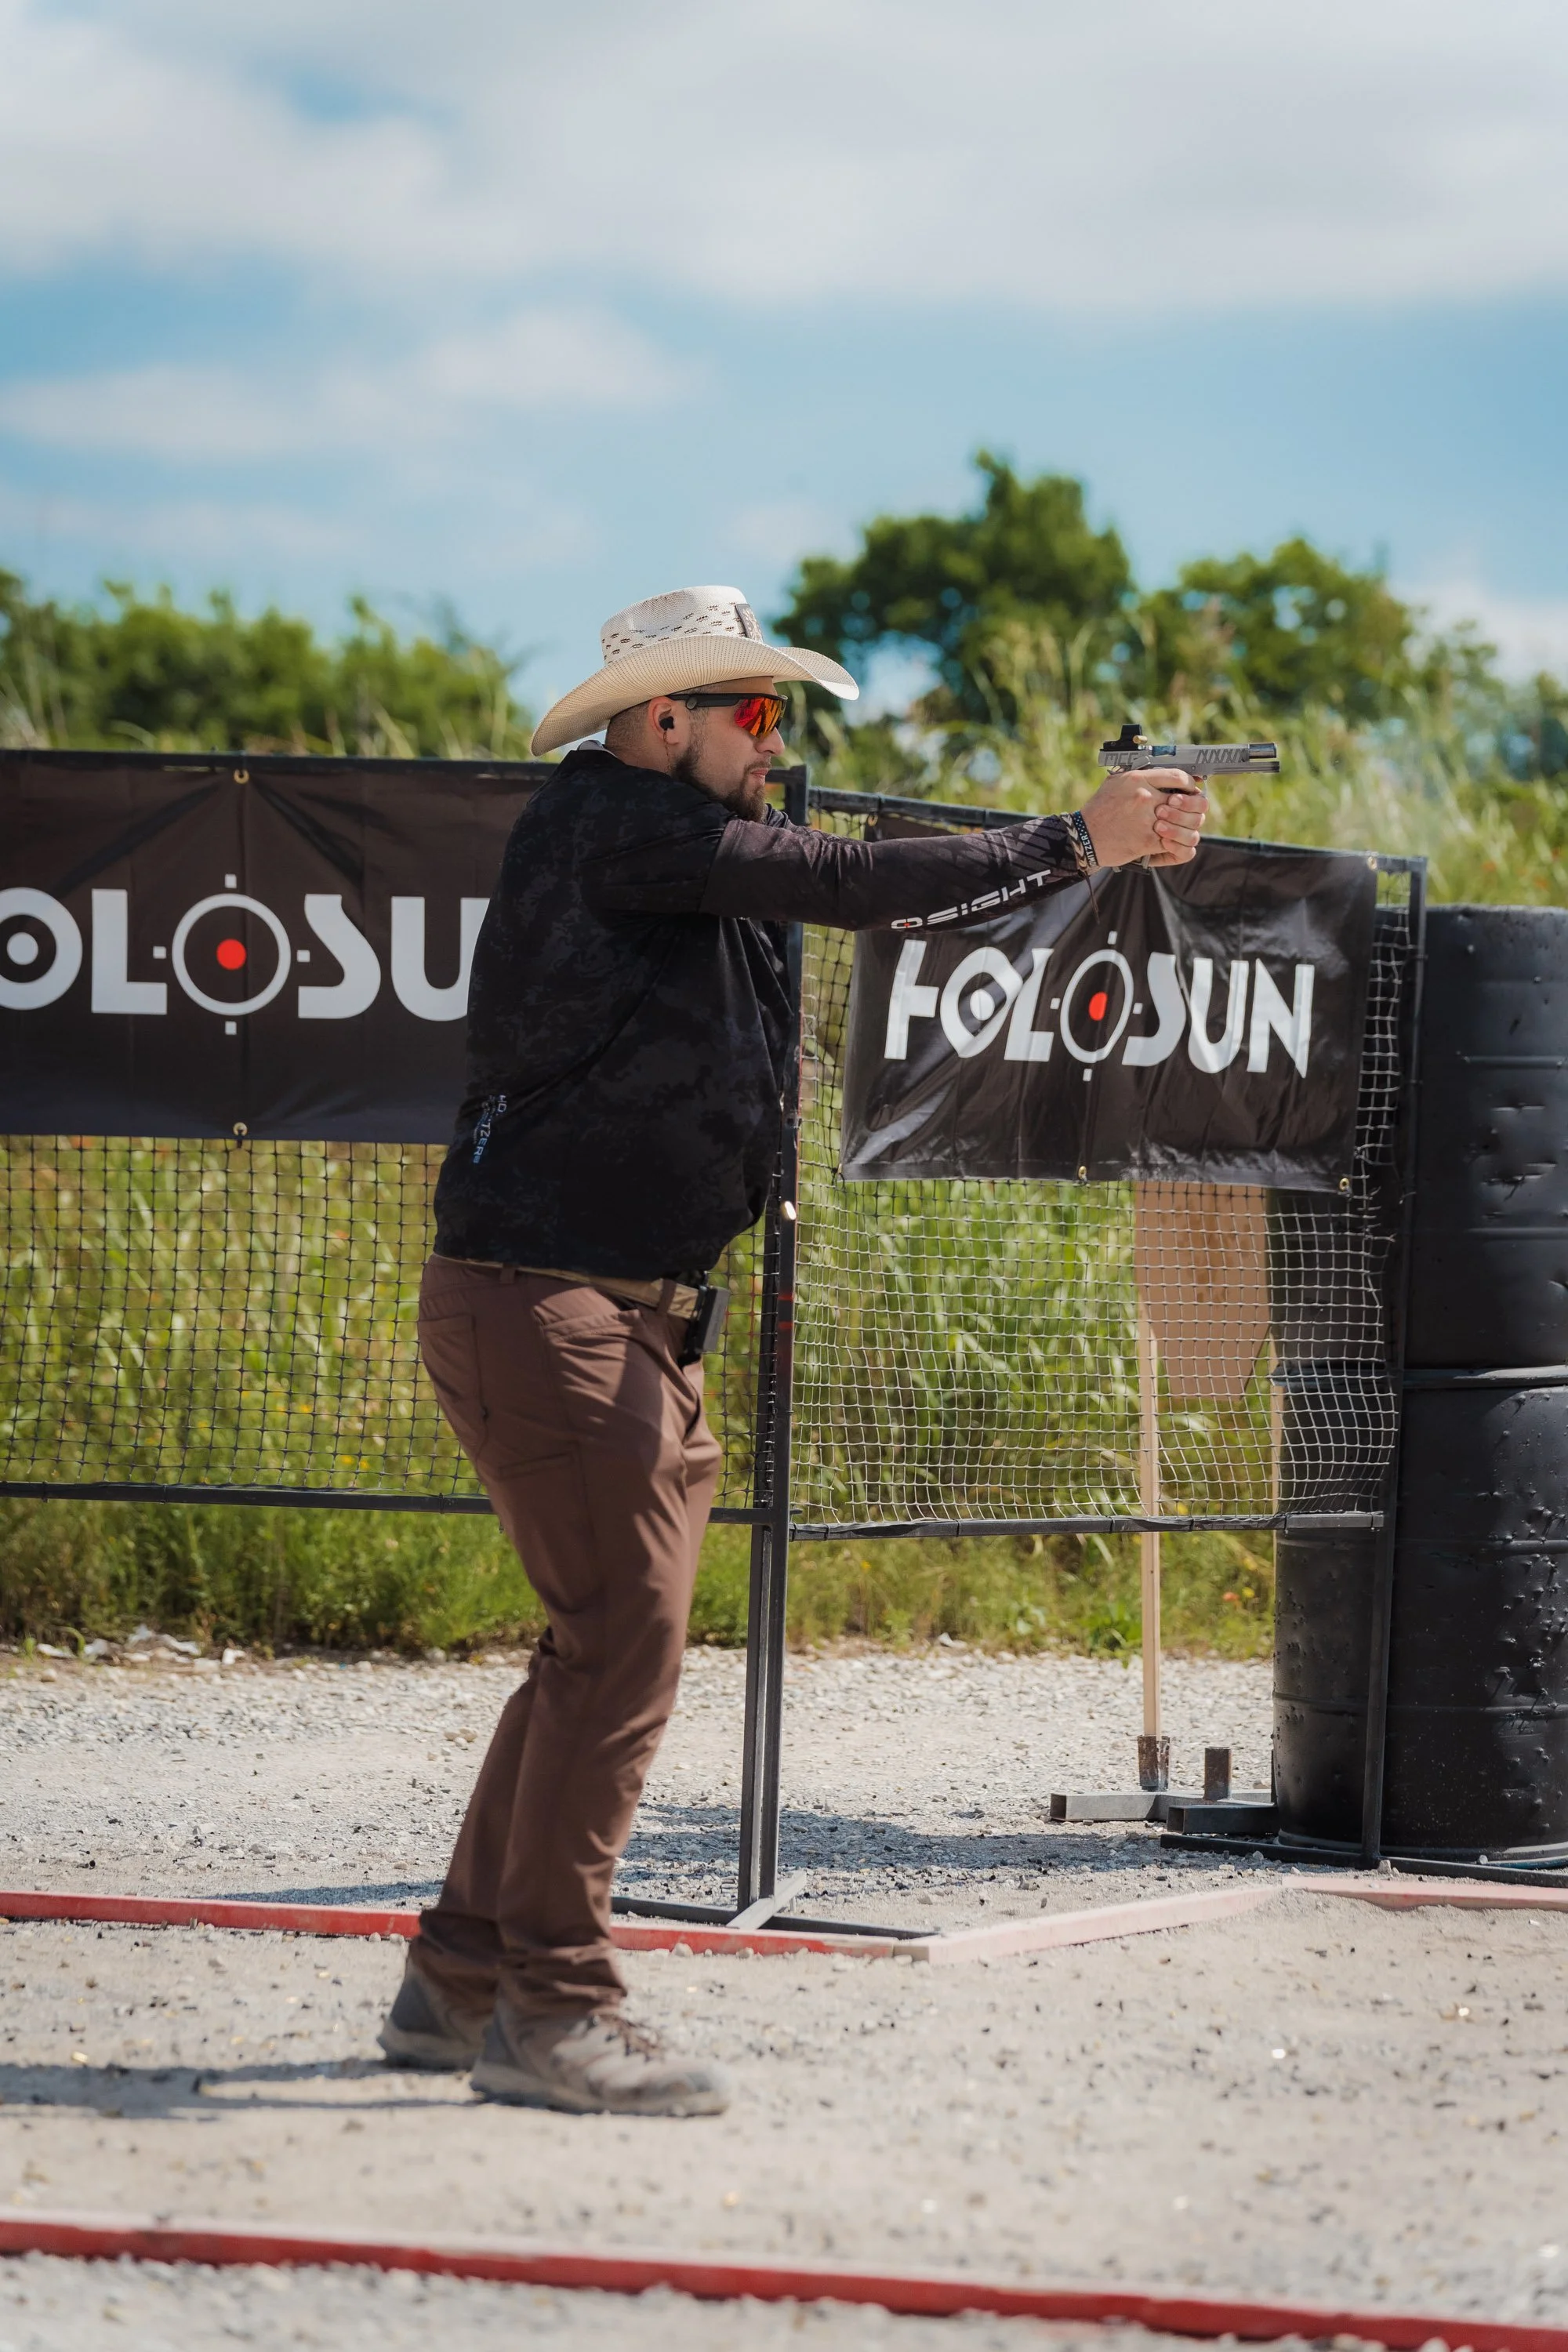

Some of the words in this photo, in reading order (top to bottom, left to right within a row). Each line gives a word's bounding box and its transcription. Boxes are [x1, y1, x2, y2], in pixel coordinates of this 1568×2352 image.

[1080, 834, 1097, 867] OWITZER
[884, 931, 1315, 1081] HOLOSUN
[474, 1094, 507, 1156] HOTZER
